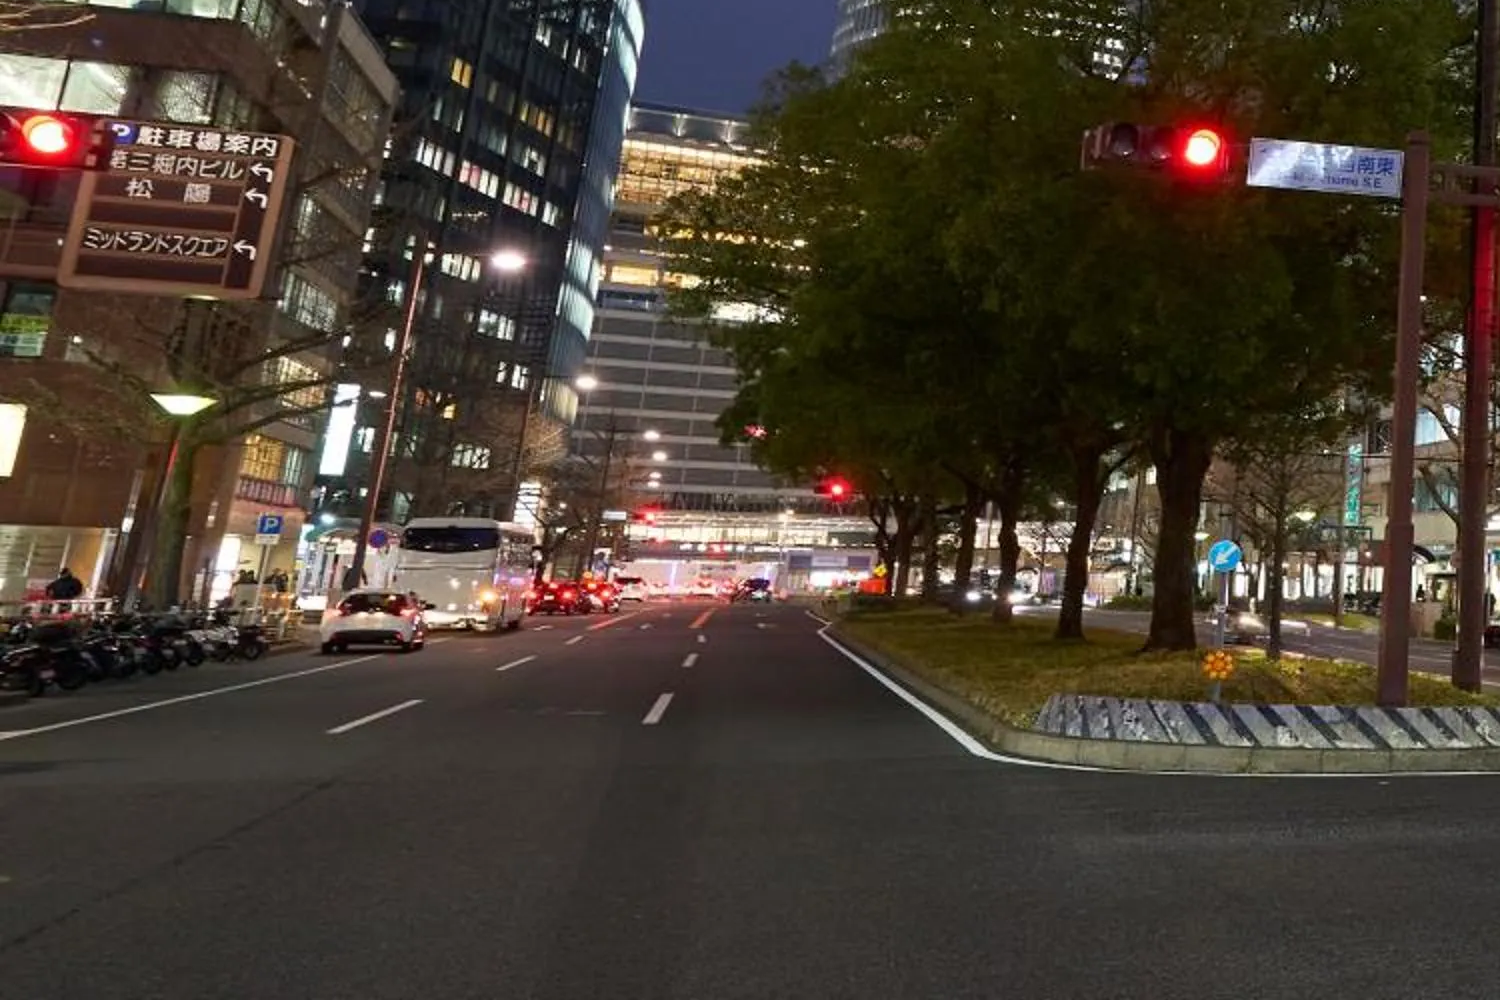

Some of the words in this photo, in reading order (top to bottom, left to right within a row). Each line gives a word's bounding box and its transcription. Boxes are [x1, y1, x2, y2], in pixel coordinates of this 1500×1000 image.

[137, 125, 278, 157] 駐車場案内
[83, 227, 229, 257] ミッドランドスクエア
